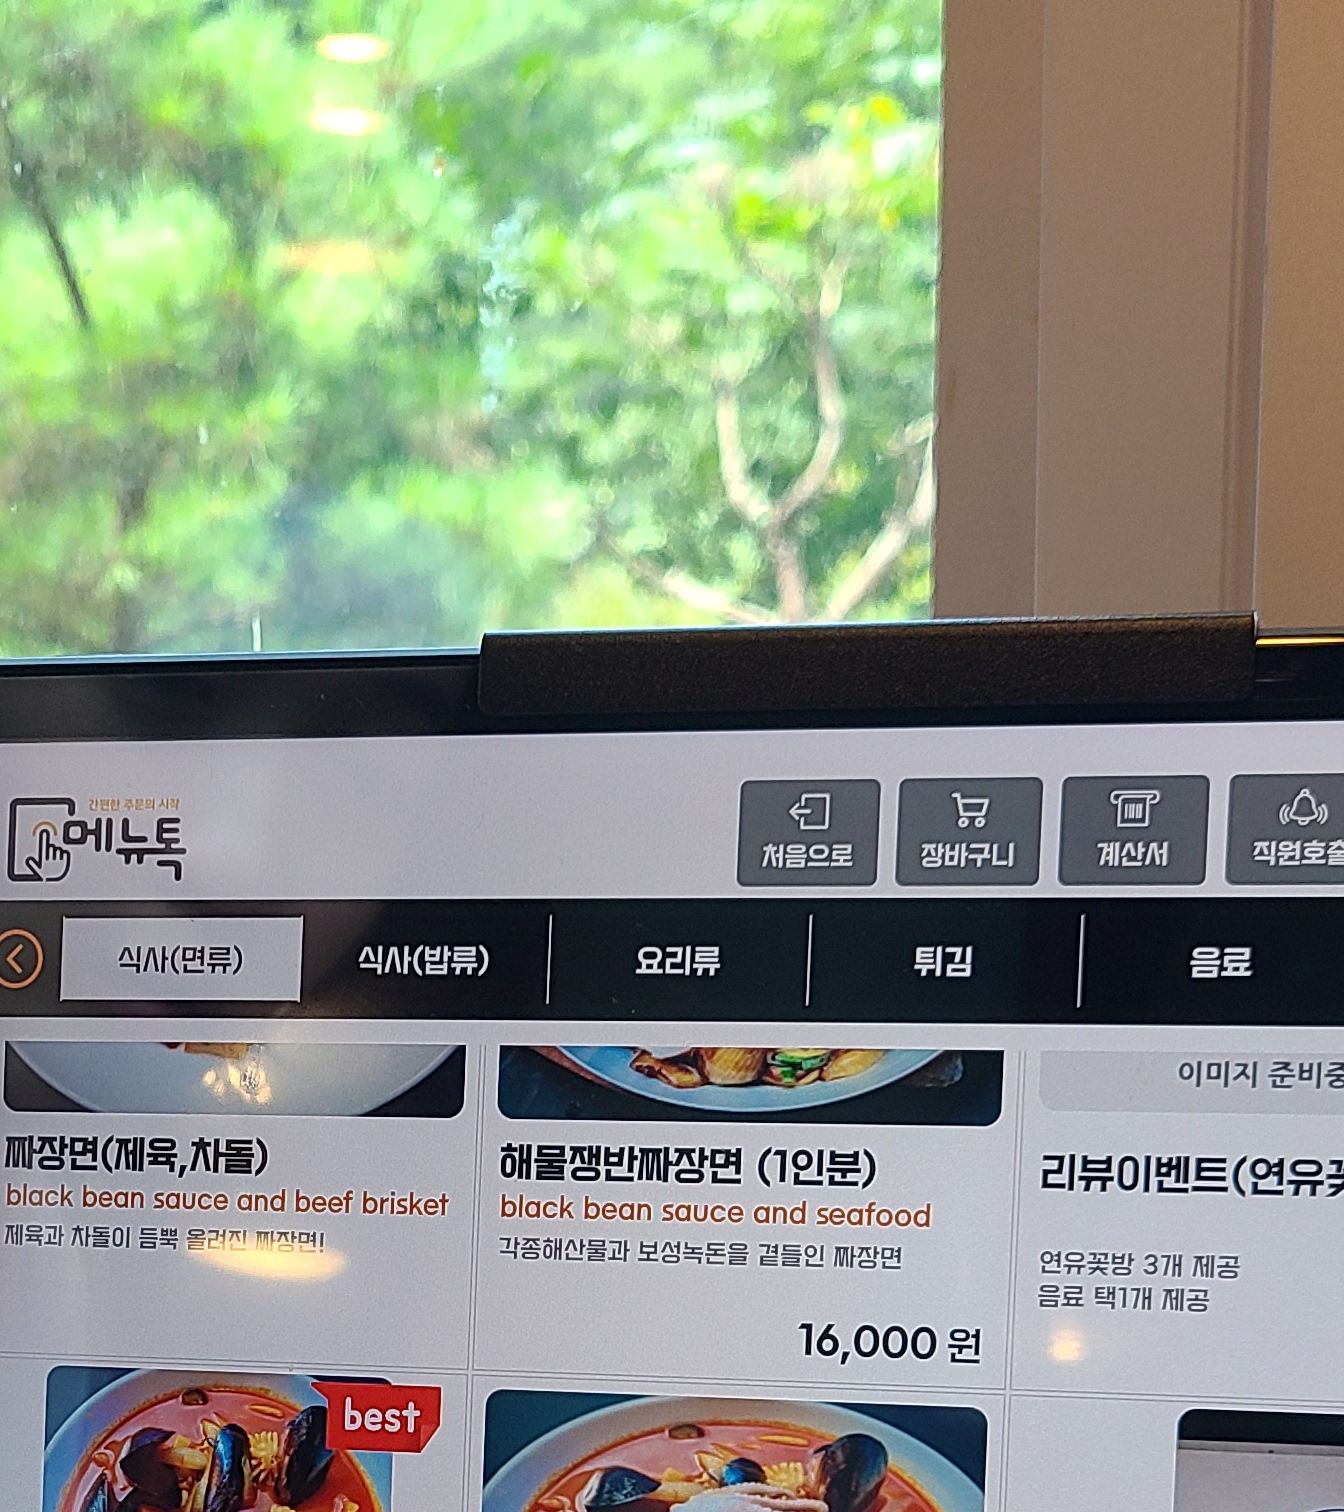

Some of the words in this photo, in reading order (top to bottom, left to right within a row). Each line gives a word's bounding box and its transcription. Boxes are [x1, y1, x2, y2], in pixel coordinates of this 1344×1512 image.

[88, 798, 121, 812] 간편한
[123, 797, 156, 811] 주문의
[158, 797, 180, 811] 시작
[60, 814, 187, 882] 메뉴톡
[761, 843, 853, 869] 처음으로
[920, 842, 1015, 868] 장바구니
[1097, 841, 1169, 867] 계산서
[118, 944, 243, 976] 식사(면류)
[358, 944, 489, 977] 식사(밥류)
[635, 945, 721, 977] 요리류
[913, 945, 973, 978] 튀김
[1189, 946, 1253, 979] 음료
[1178, 1060, 1258, 1089] 이미지
[4, 1134, 268, 1179] 짜장면(제육,차돌)
[500, 1142, 742, 1185] 해물쟁반짜장면
[757, 1146, 876, 1190] (1인분)
[6, 1182, 74, 1208] black
[82, 1184, 145, 1209] bean
[152, 1192, 229, 1211] sauce
[237, 1188, 286, 1212] and
[295, 1188, 354, 1214] beef
[362, 1190, 450, 1216] brisket
[500, 1193, 575, 1220] black
[583, 1195, 652, 1221] bean
[661, 1203, 744, 1223] sauce
[753, 1200, 807, 1225] and
[816, 1201, 931, 1228] seafood
[4, 1223, 65, 1247] 제육과
[70, 1224, 131, 1249] 차돌이
[138, 1227, 179, 1250] 듬뿍
[185, 1229, 248, 1252] 올려진
[254, 1230, 325, 1254] 짜장면!
[498, 1236, 631, 1263] 각종해산물과
[758, 1243, 825, 1268] 곁들인
[833, 1245, 902, 1270] 짜장면
[1143, 1253, 1183, 1278] 3개
[1192, 1254, 1241, 1279] 제공
[1037, 1284, 1085, 1308] 음료
[1094, 1285, 1153, 1311] 택1개
[1161, 1287, 1210, 1313] 제공
[798, 1322, 937, 1365] 16,000
[947, 1328, 981, 1364] 원
[344, 1396, 421, 1433] best
